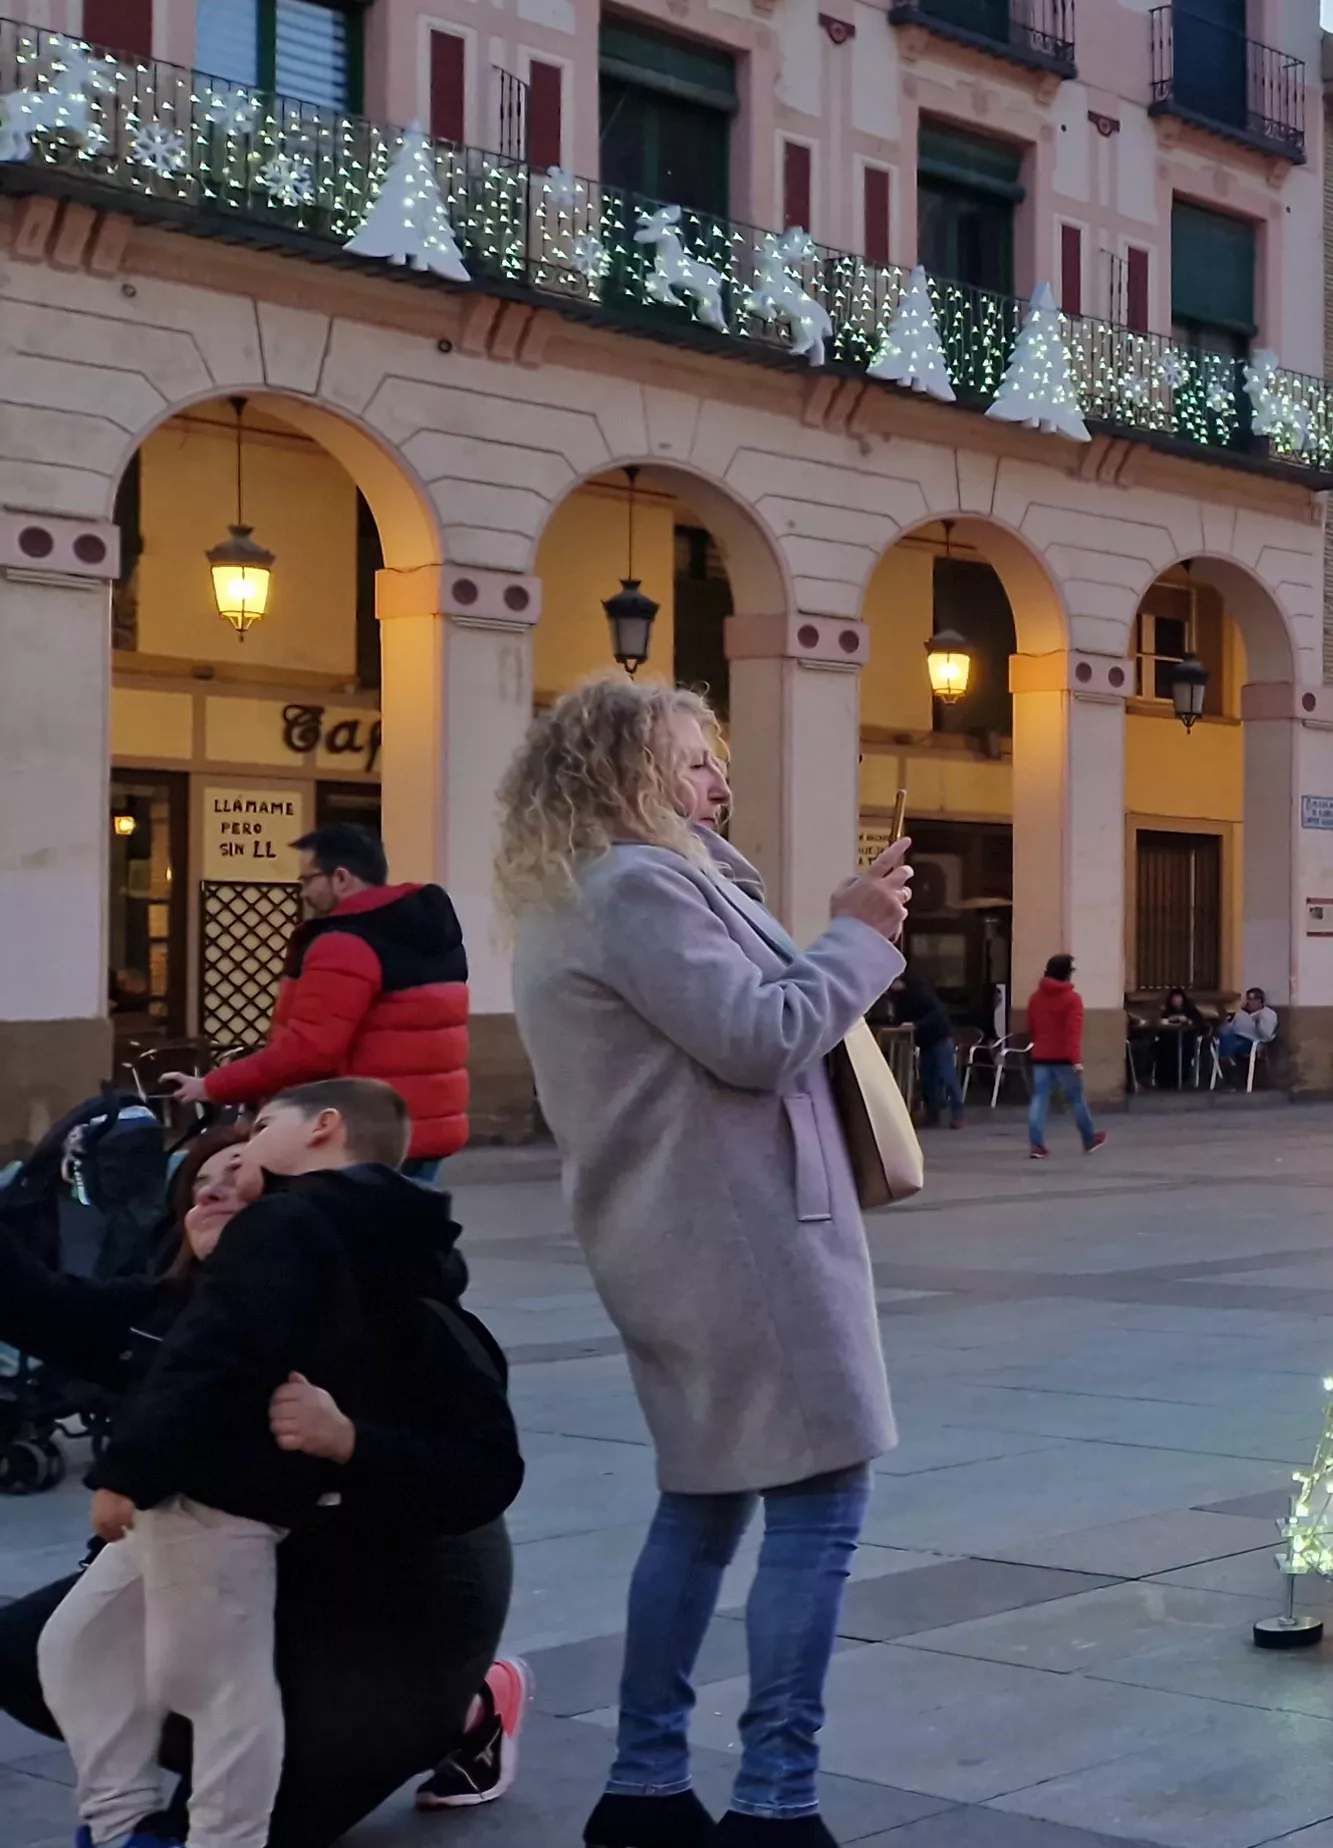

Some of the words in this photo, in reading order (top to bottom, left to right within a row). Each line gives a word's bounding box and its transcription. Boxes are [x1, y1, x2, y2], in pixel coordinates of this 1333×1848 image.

[221, 822, 262, 835] PERO
[219, 842, 245, 857] SIN
[252, 840, 277, 858] LL
